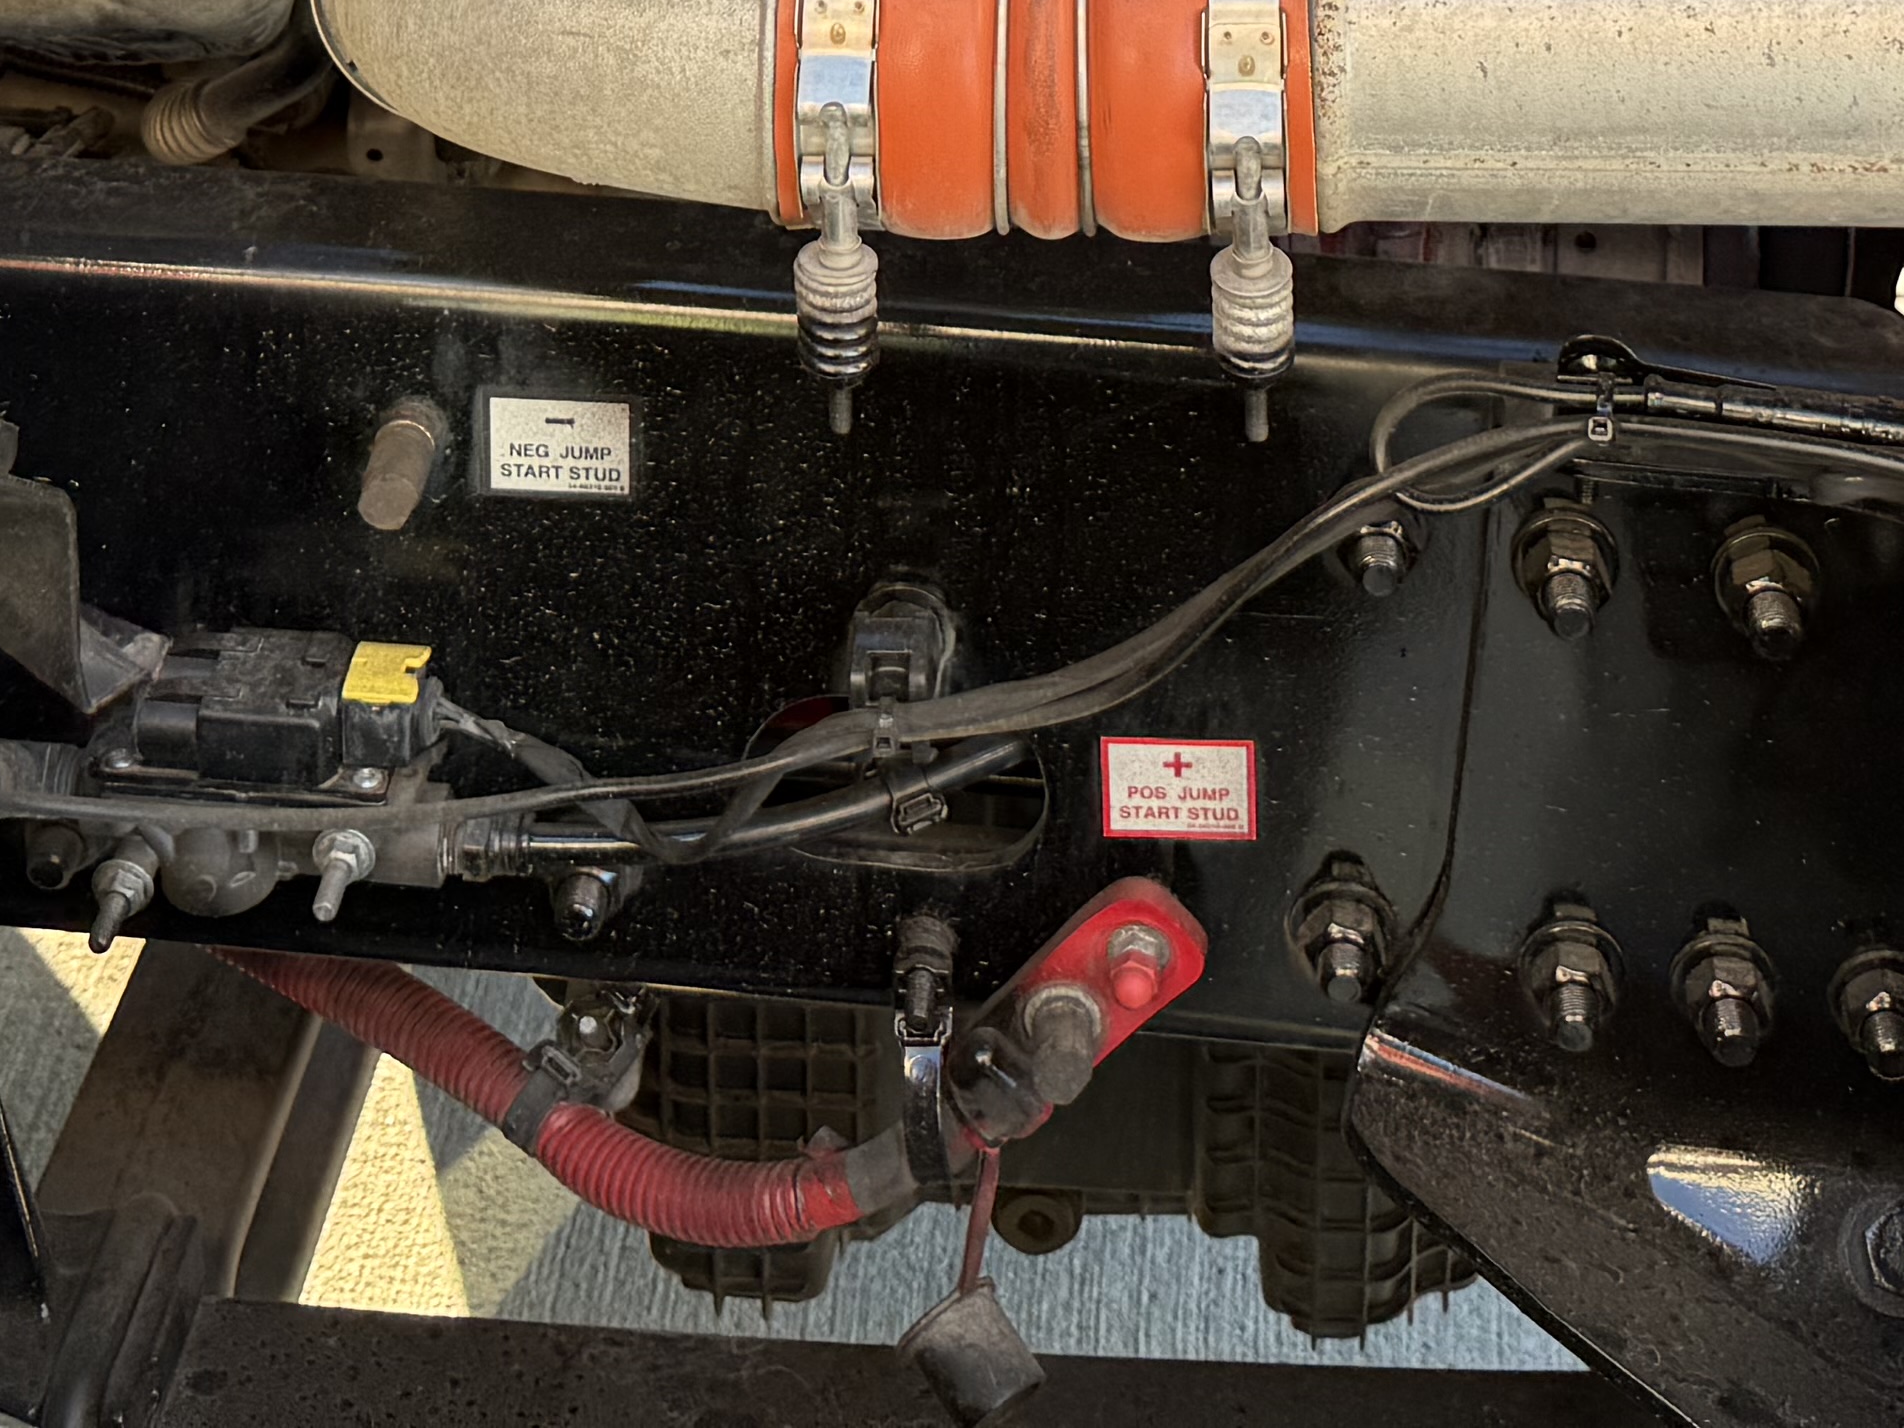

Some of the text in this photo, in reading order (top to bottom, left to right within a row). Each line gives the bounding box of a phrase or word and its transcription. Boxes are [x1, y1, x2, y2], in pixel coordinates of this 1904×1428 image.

[509, 442, 612, 460] NEG JUMP
[500, 463, 621, 482] START STUD
[1127, 786, 1230, 801] POS JUMP
[1119, 805, 1239, 821] START STUD
